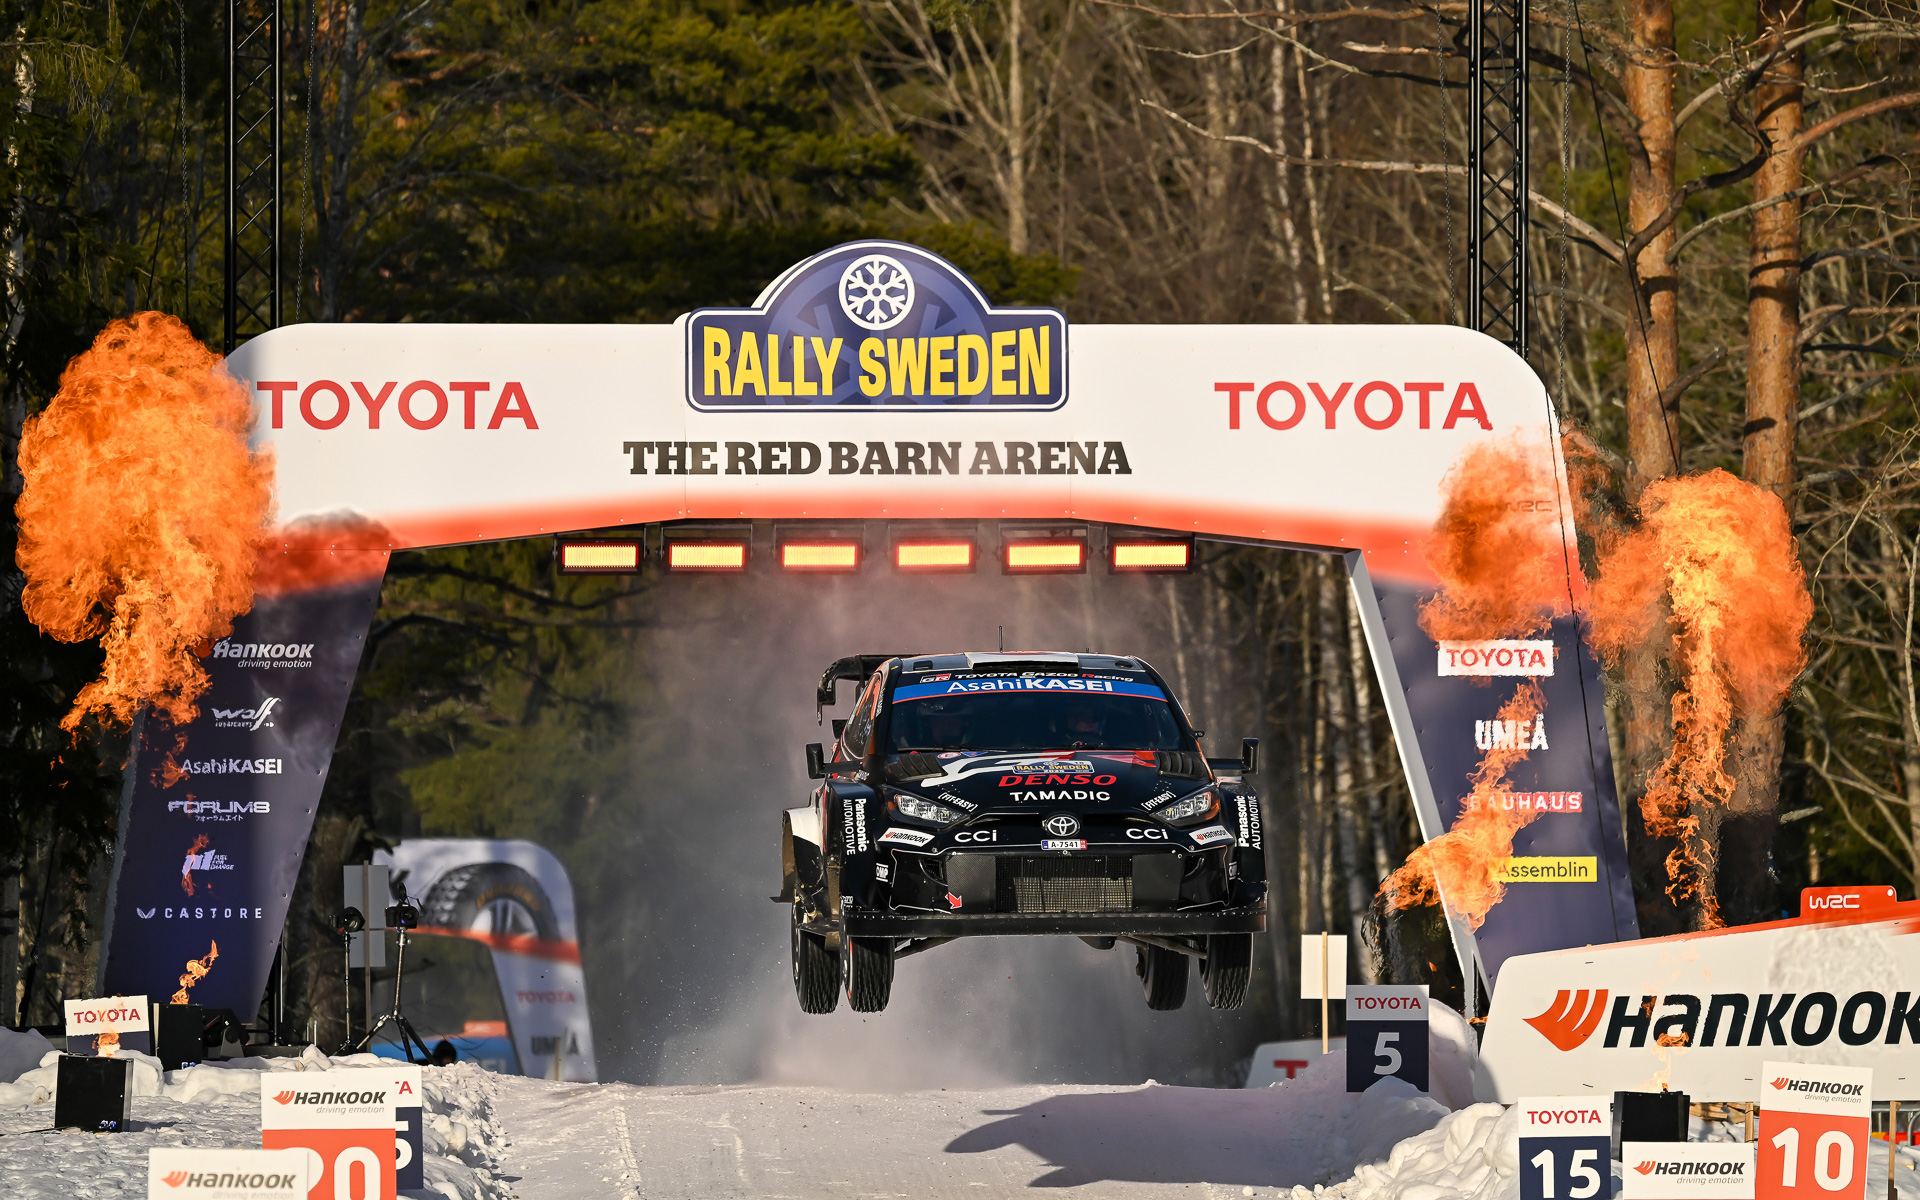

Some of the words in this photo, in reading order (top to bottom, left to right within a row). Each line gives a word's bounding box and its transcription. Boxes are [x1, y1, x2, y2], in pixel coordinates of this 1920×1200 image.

[703, 325, 843, 397] RALLY
[858, 325, 1050, 397] SWEDEN
[257, 380, 539, 430] TOYOTA
[1214, 381, 1493, 430] TOYOTA
[623, 442, 718, 475] THE
[725, 442, 821, 475] RED
[828, 442, 960, 475] BARN
[969, 442, 1132, 475] ARENA
[238, 660, 270, 669] driving
[273, 660, 312, 668] emotion
[1446, 648, 1546, 668] TOYOTA
[1475, 713, 1549, 750] UMEÅ
[998, 774, 1117, 787] DENSO
[1009, 790, 1110, 801] TAMADIC
[1469, 795, 1581, 810] BAUHAUS
[168, 800, 270, 814] FORUM8
[843, 799, 856, 856] AUTOMOTIVE
[855, 798, 869, 852] Panasonic
[1234, 795, 1250, 848] Panasonic
[1248, 795, 1261, 850] AUTOMOTIVE
[1498, 861, 1588, 878] Assemblin
[1809, 894, 1860, 909] WRC
[164, 907, 262, 919] CASTORE
[1355, 997, 1421, 1010] TOYOTA
[73, 1008, 141, 1024] TOYOTA
[1373, 1032, 1402, 1075] 5
[1804, 1093, 1830, 1103] driving
[1831, 1096, 1862, 1104] emotion
[316, 1106, 346, 1115] driving
[348, 1106, 385, 1114] emotion
[1527, 1110, 1602, 1124] TOYOTA
[1771, 1127, 1855, 1191] 10
[1531, 1149, 1600, 1199] 15
[1676, 1176, 1706, 1185] driving
